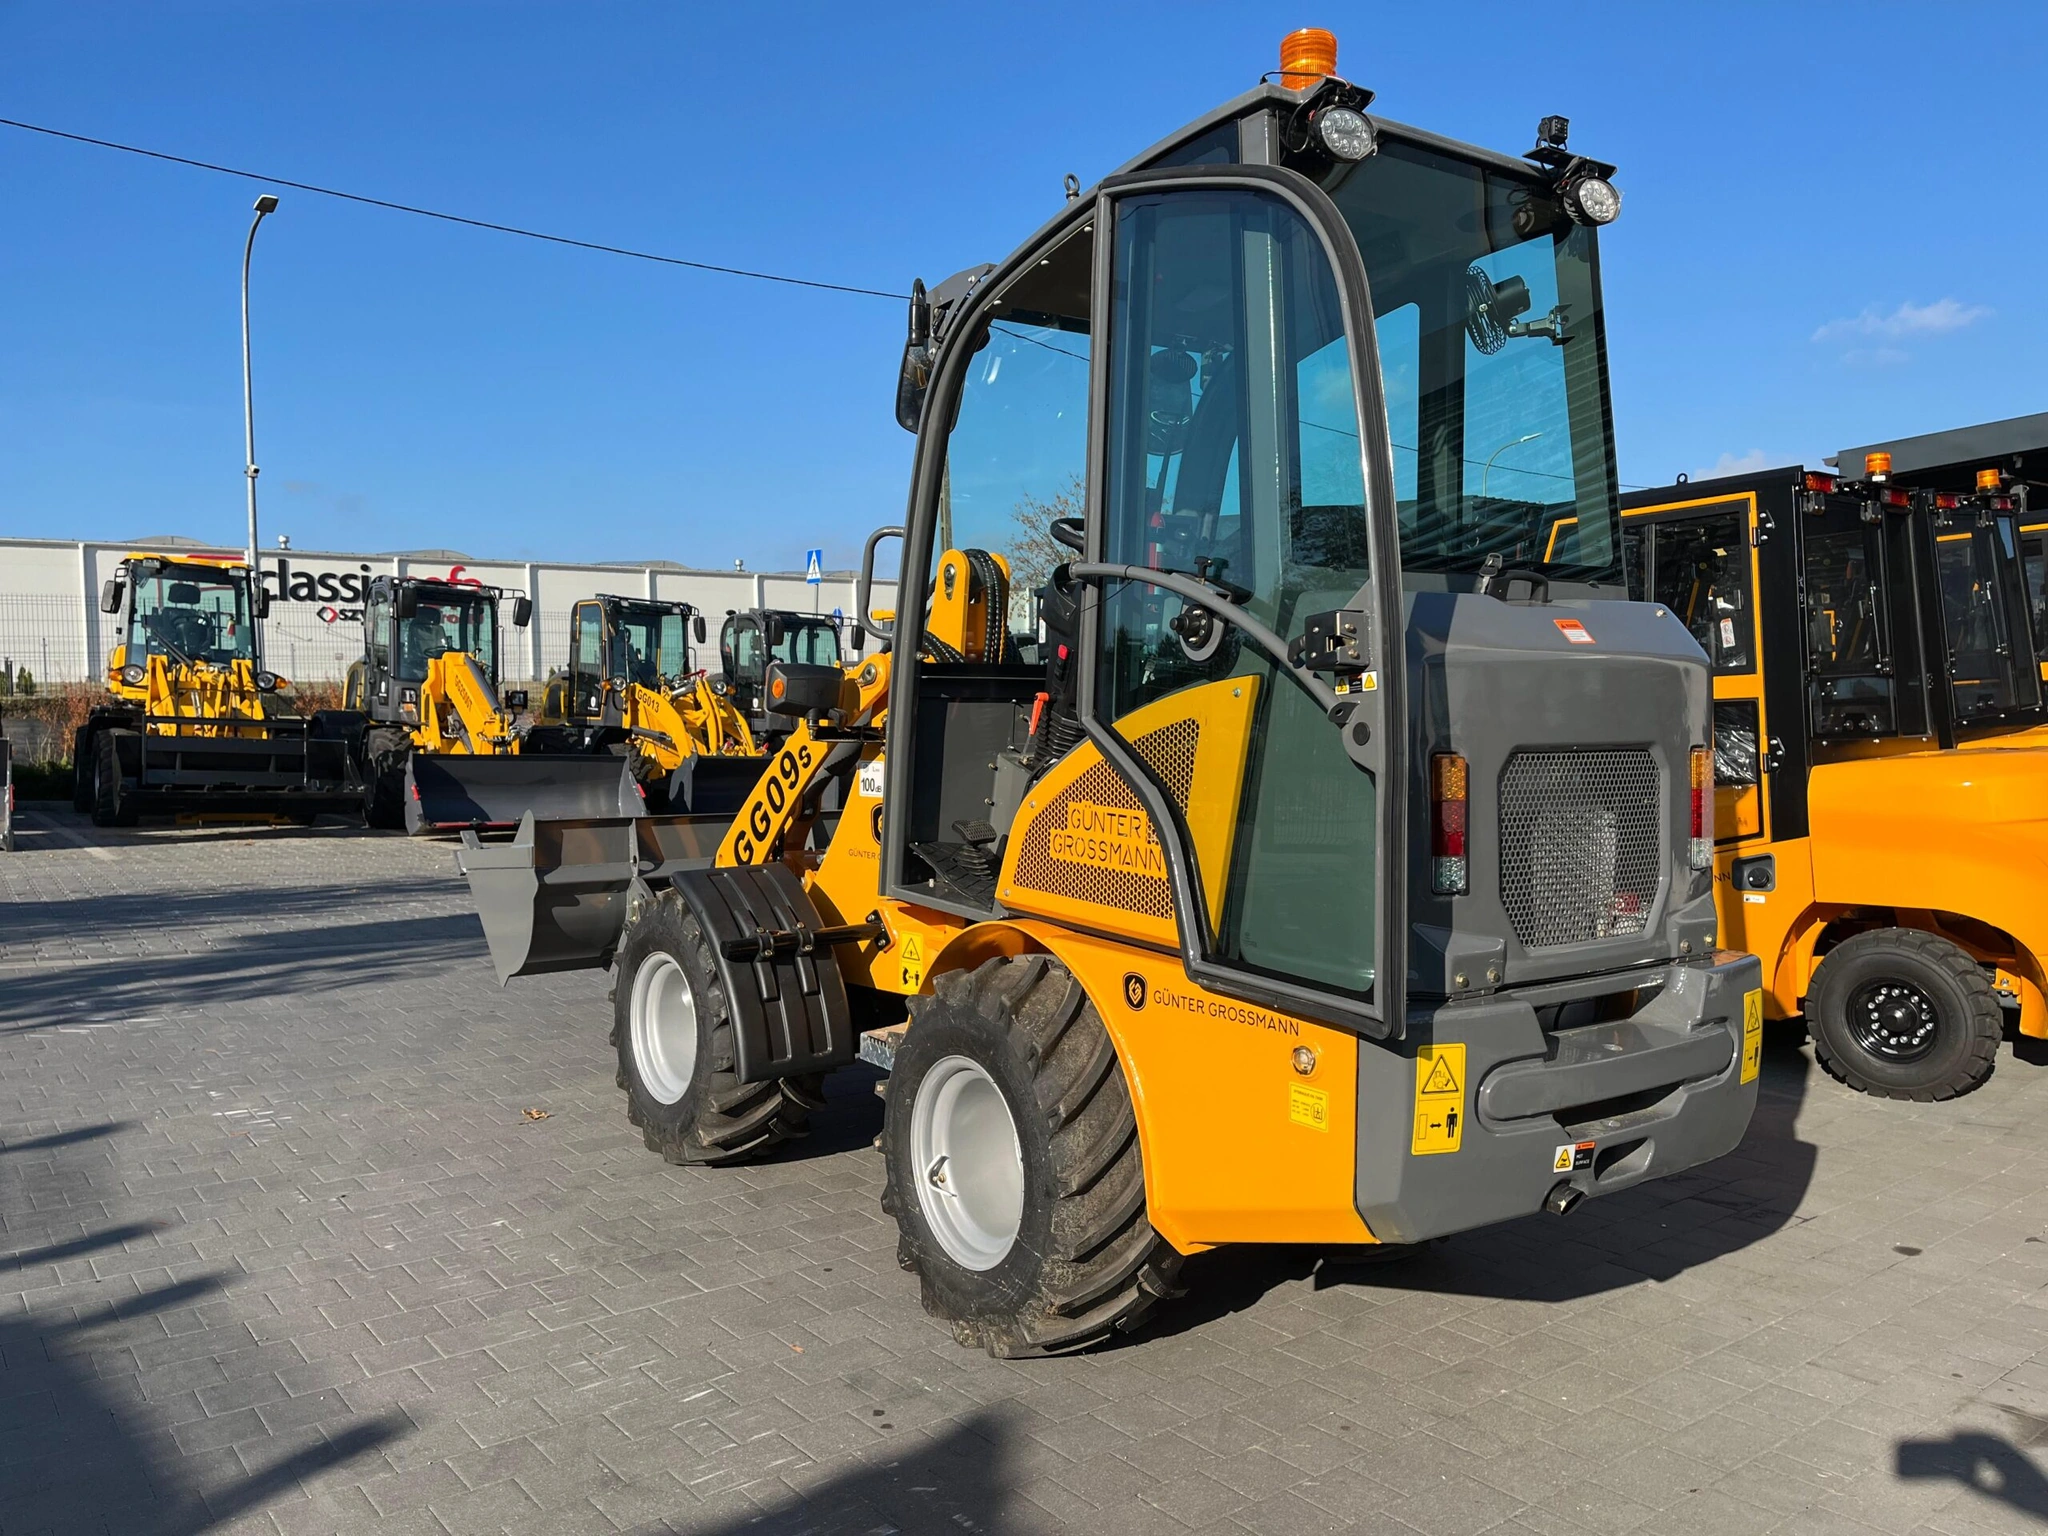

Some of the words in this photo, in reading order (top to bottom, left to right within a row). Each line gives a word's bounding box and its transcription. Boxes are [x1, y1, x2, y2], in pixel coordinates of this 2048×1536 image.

[259, 558, 372, 604] classi
[637, 689, 660, 713] GG013
[861, 777, 875, 792] 100
[1070, 804, 1143, 839] GÜNTER
[848, 847, 876, 860] GÜNTER
[1052, 832, 1163, 873] GROSSMANN
[1153, 987, 1206, 1015] GÜNTER
[1208, 1002, 1300, 1037] GROSSMANN
